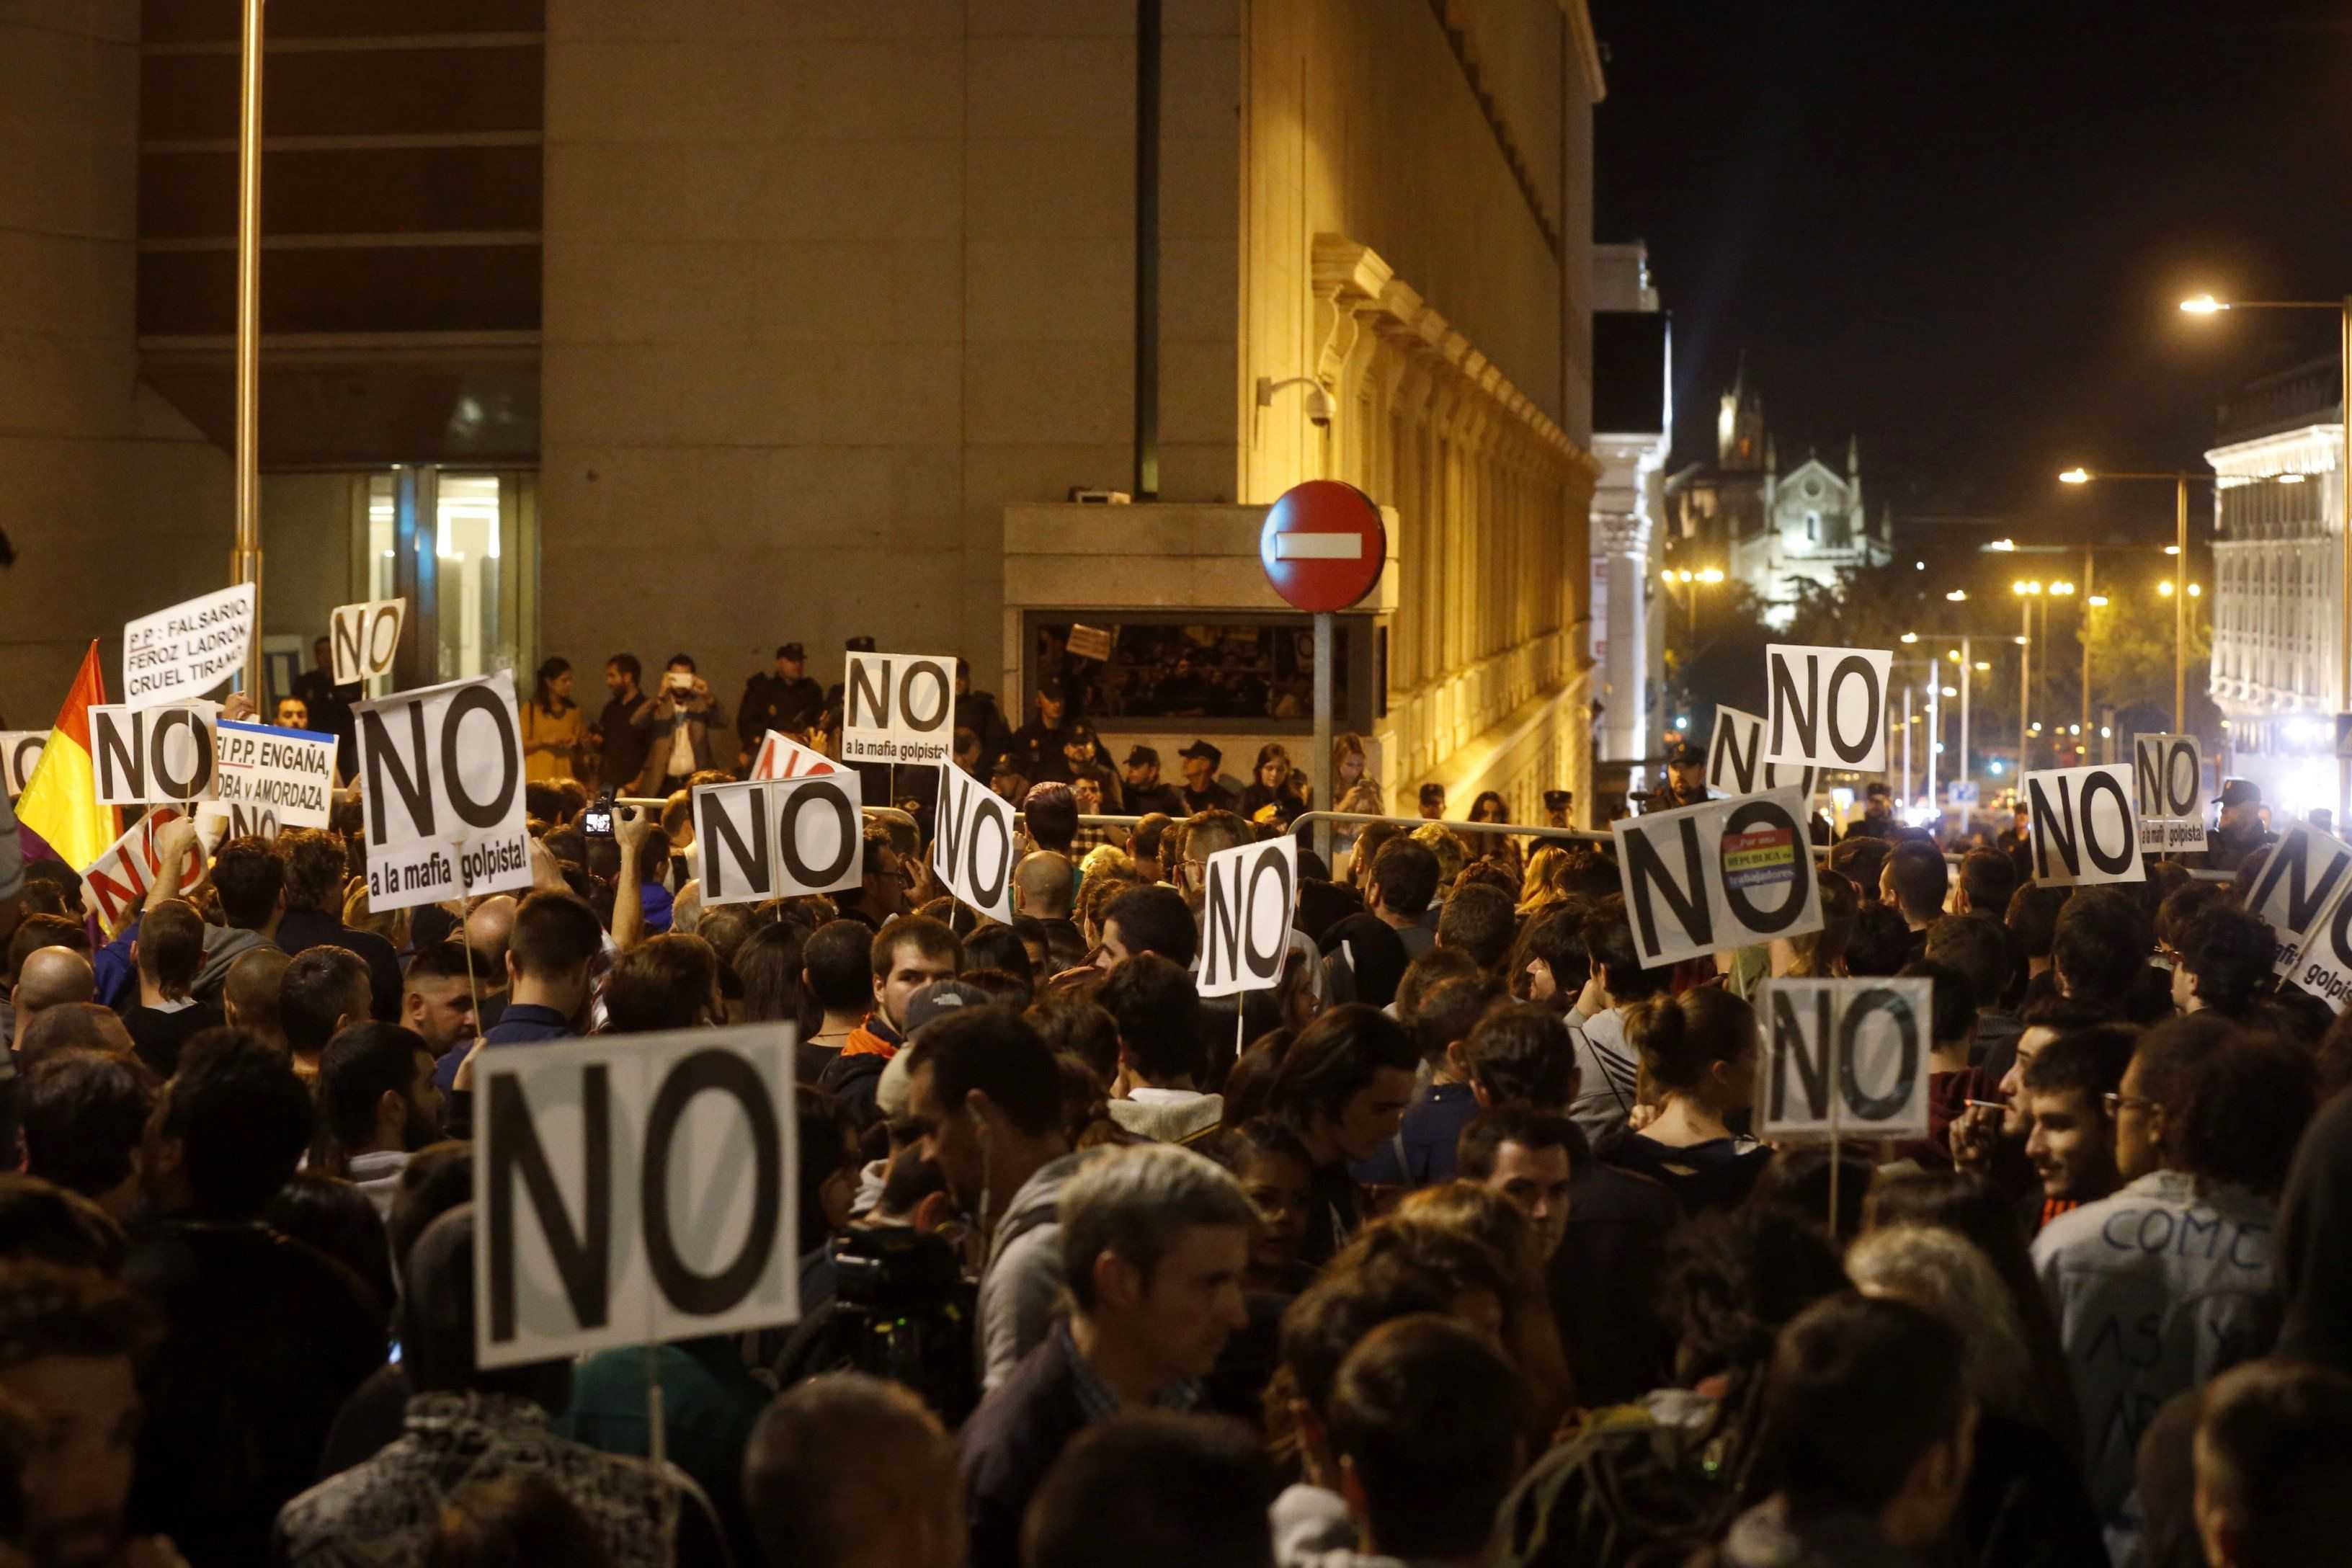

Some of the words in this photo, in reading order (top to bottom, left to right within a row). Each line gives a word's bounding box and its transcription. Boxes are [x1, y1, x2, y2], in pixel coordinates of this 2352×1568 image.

[128, 646, 179, 672] FEROZ
[129, 669, 184, 696] CRUEL
[335, 606, 399, 679] NO
[847, 658, 950, 732] NO
[1770, 653, 1880, 764] NO
[96, 708, 212, 799] NO
[260, 742, 329, 779] ENGAÑA,
[362, 685, 518, 845] NO
[846, 741, 852, 754] a
[855, 739, 864, 755] la
[867, 741, 897, 757] mafia
[2137, 740, 2199, 816] NO
[254, 778, 326, 811] AMORDAZA.
[936, 763, 1009, 908] NO
[2028, 771, 2134, 878] NO
[2169, 824, 2204, 847] golpista!
[371, 872, 380, 896] a
[385, 862, 399, 894] la
[404, 852, 452, 890] mafia
[461, 834, 526, 888] golpista!
[700, 781, 857, 898] NO
[1623, 801, 1809, 958] NO
[1204, 846, 1291, 986] NO
[1769, 988, 1918, 1122] NO
[487, 1046, 780, 1345] NO
